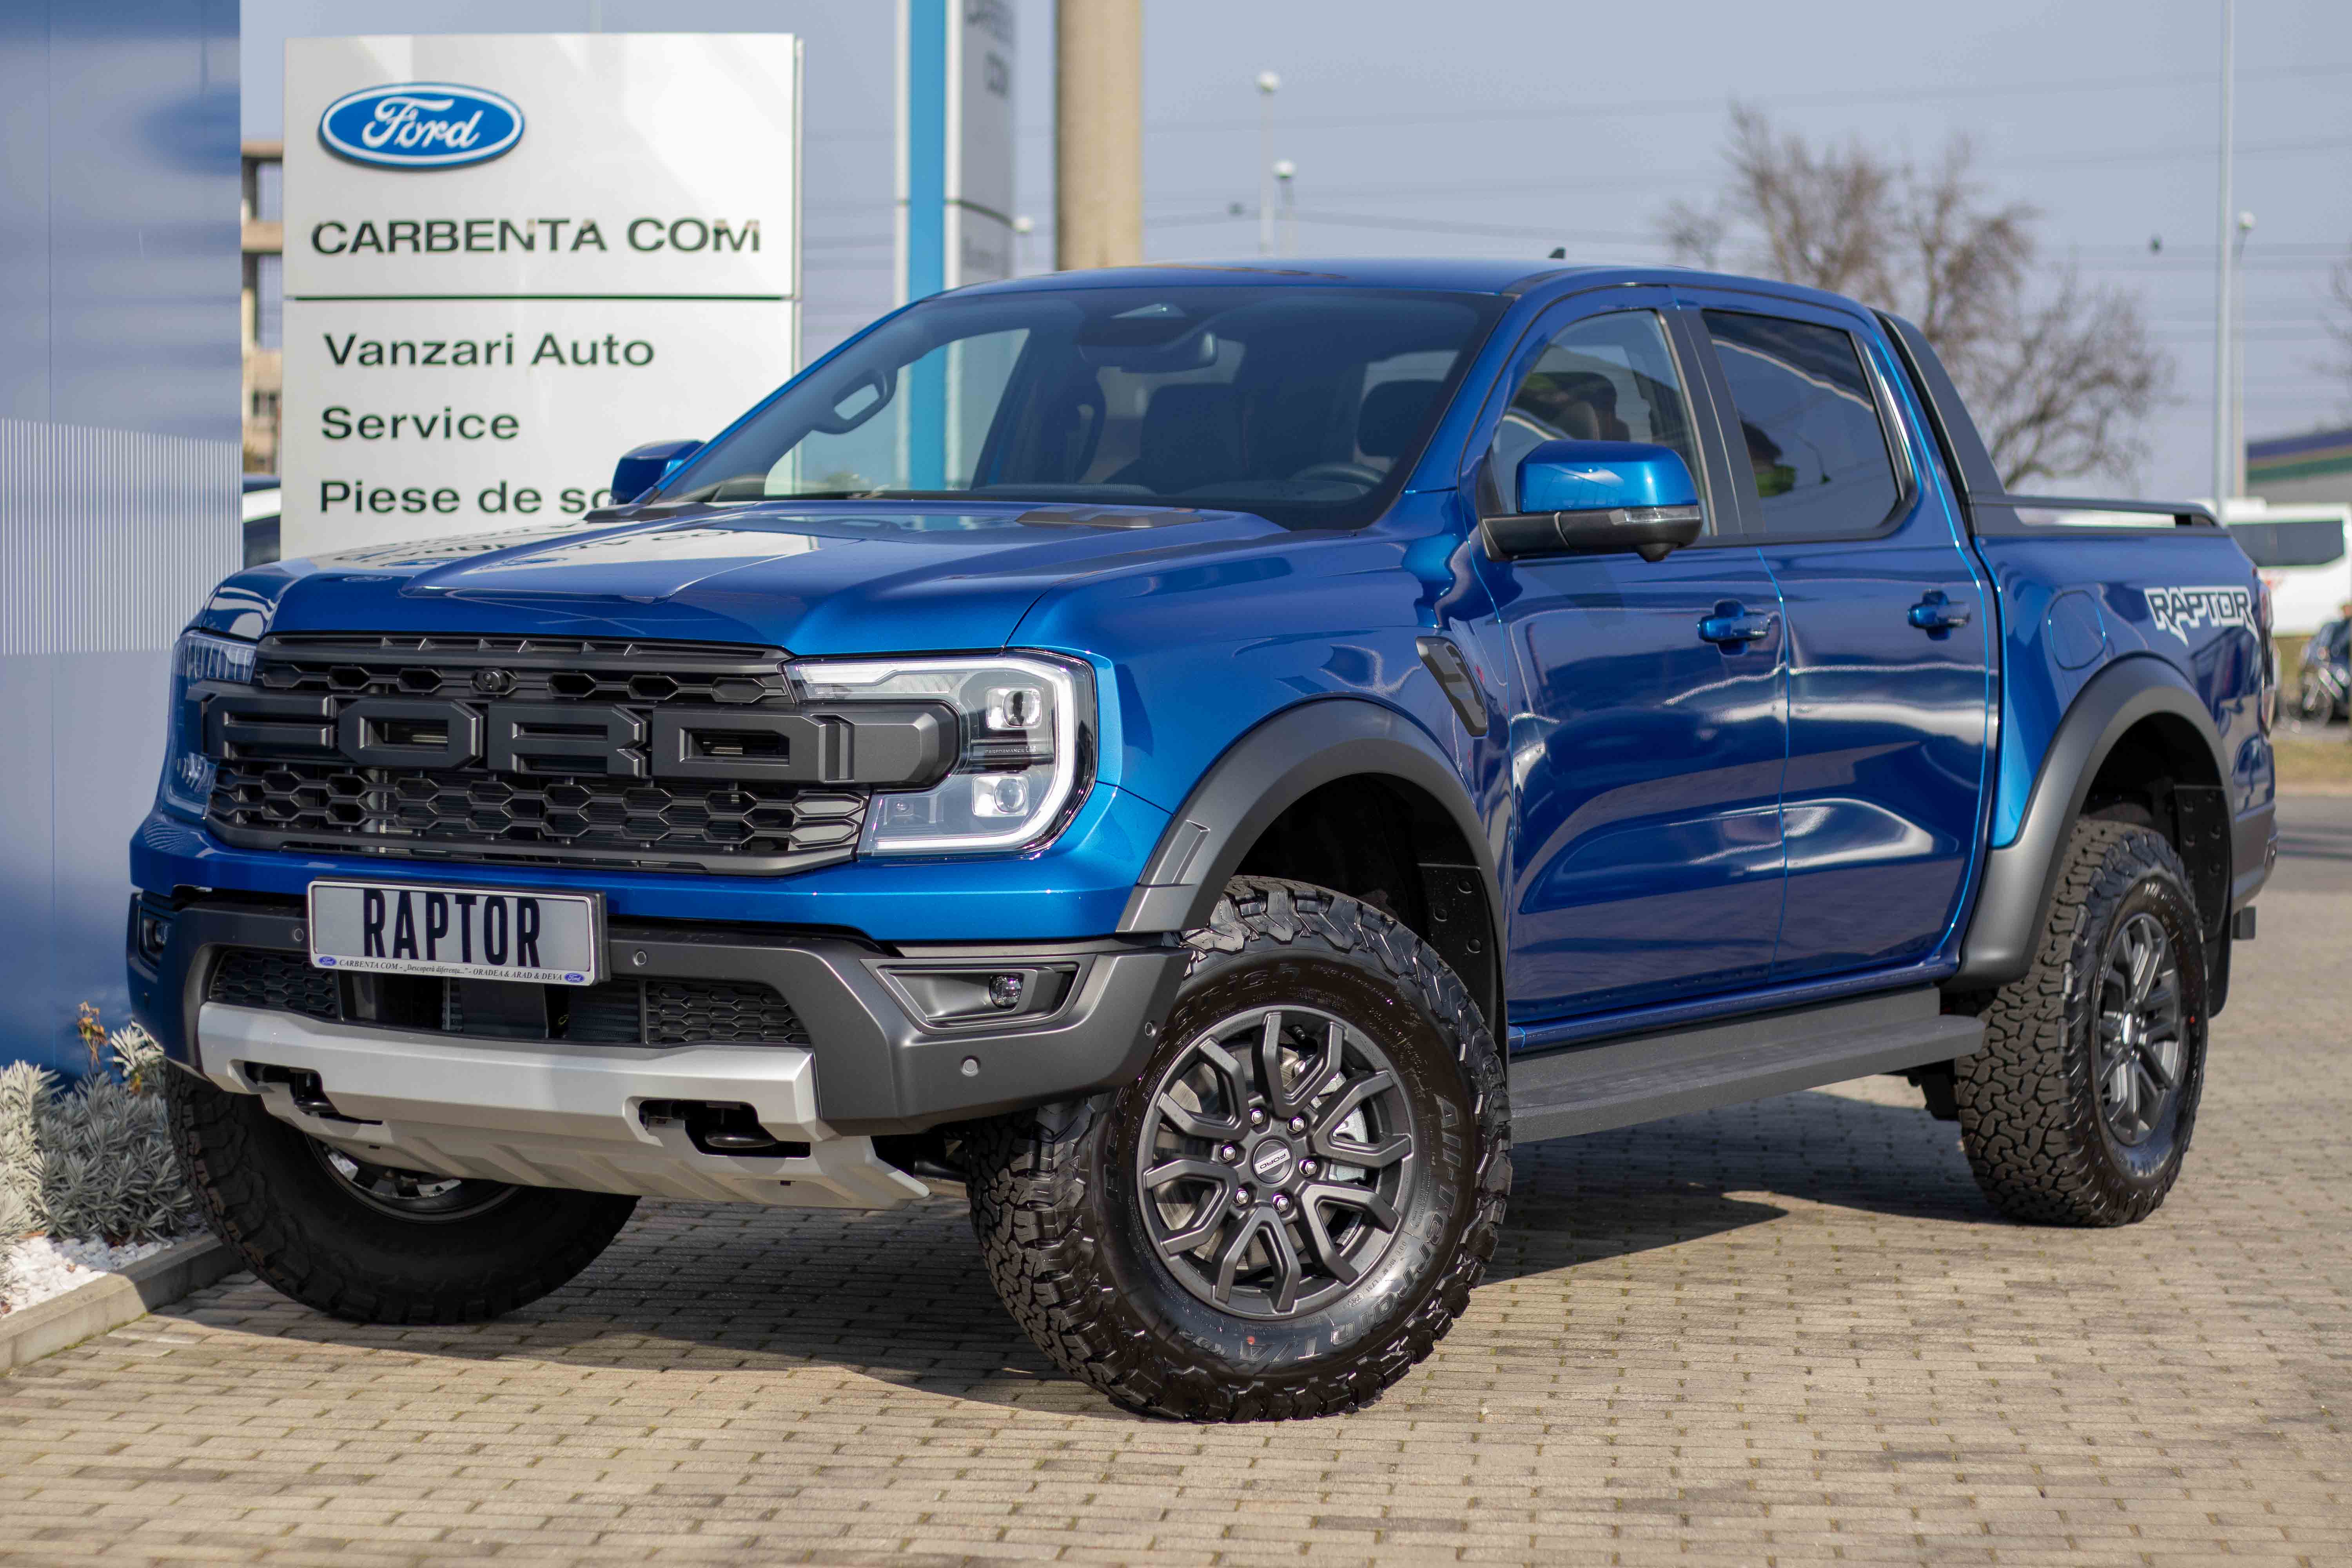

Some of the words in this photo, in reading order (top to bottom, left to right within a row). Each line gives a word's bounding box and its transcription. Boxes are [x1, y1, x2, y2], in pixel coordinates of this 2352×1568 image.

[361, 96, 485, 149] Ford
[311, 219, 608, 256] CARBENTA
[627, 218, 760, 253] COM
[324, 333, 514, 368] Vanzari
[531, 334, 655, 367] Auto
[321, 406, 520, 441] Service
[320, 481, 461, 514] Piese
[478, 481, 543, 514] de
[2143, 586, 2260, 648] RAPTOR
[202, 693, 826, 783] FORD
[363, 888, 541, 967] RAPTOR
[339, 959, 379, 969] CARBENTA
[473, 968, 503, 976] ORADEA
[1260, 1153, 1286, 1169] FORD
